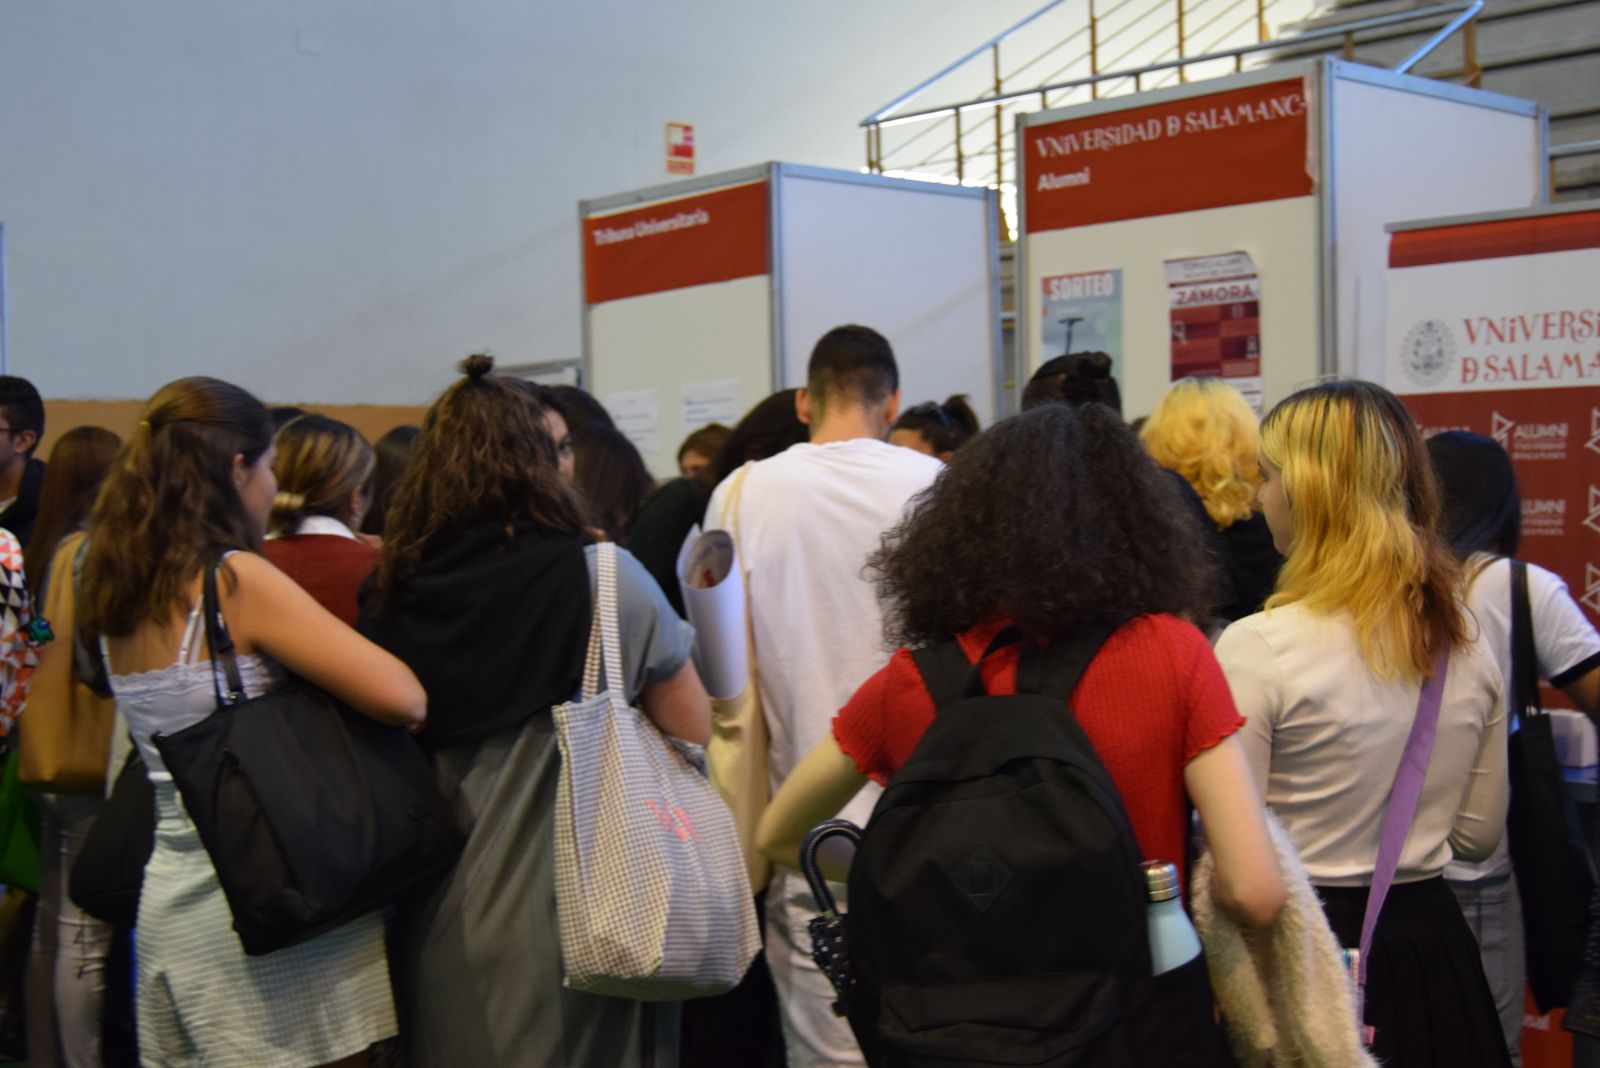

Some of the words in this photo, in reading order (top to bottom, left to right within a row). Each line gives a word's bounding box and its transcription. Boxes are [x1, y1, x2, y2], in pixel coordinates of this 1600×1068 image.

[1037, 165, 1091, 191] Alumni
[593, 226, 635, 246] Tribuna
[634, 207, 710, 238] Universitaria
[1050, 272, 1114, 301] SORTEO
[1176, 283, 1255, 305] ZAMORA
[1513, 422, 1569, 439] ALUMNI
[1520, 499, 1567, 514] LUMNI
